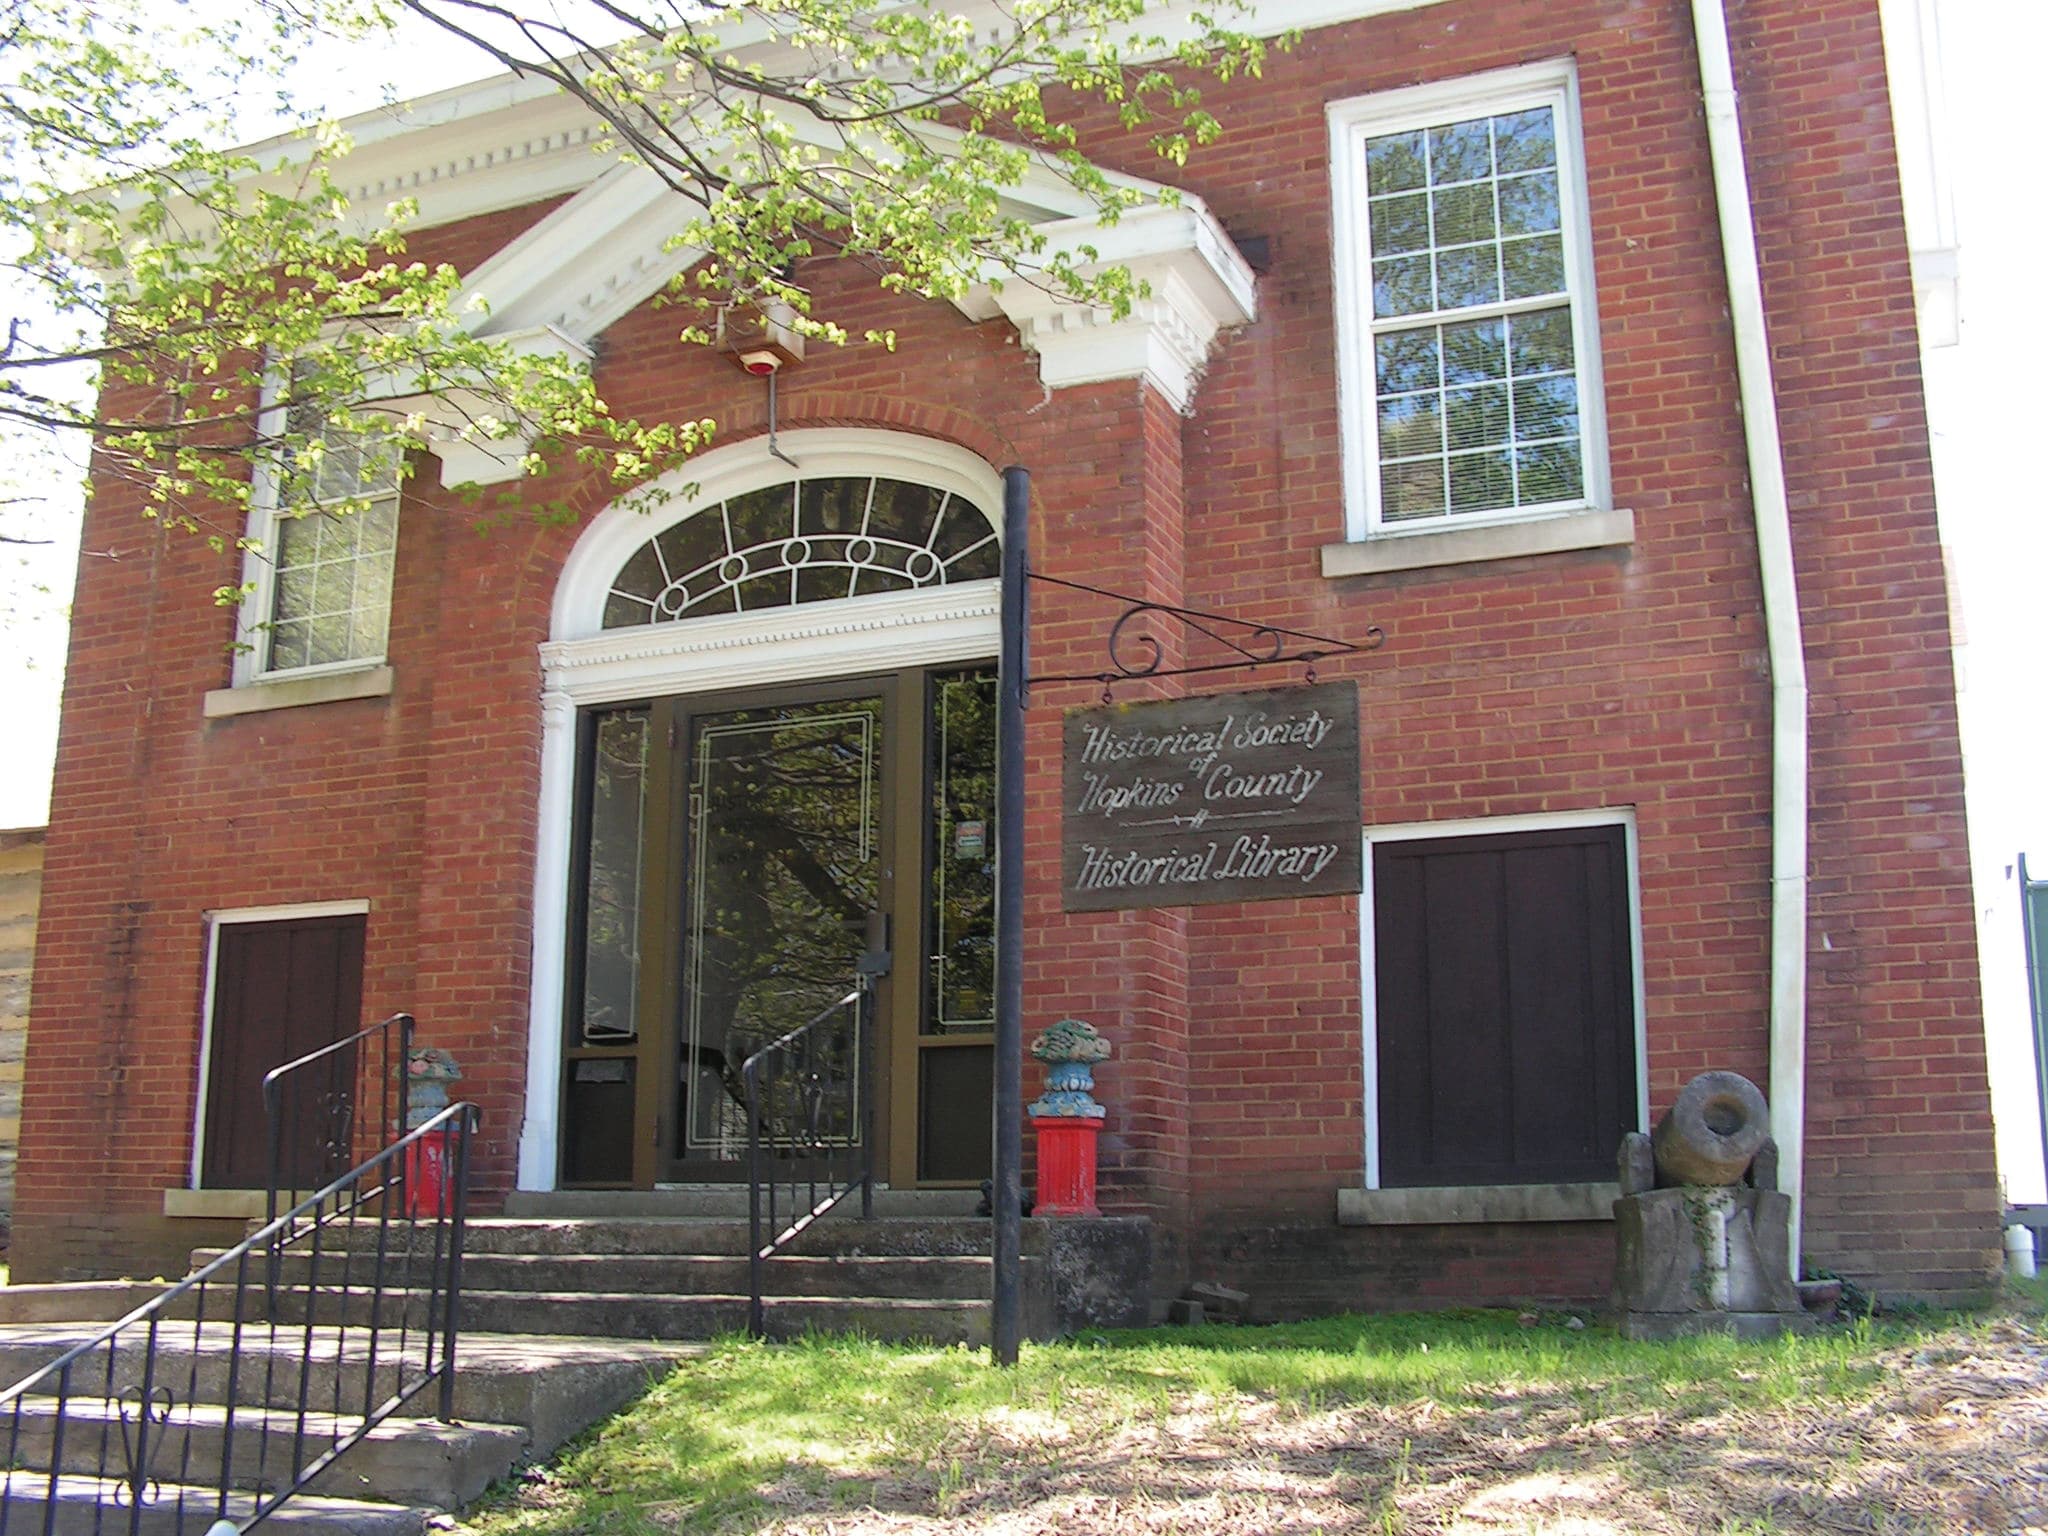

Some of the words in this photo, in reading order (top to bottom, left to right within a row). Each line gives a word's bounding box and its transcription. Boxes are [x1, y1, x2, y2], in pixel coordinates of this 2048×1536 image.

[1079, 714, 1234, 763] Historical
[1234, 711, 1334, 750] Society
[1078, 770, 1184, 818] Hopkins
[1204, 764, 1323, 804] County
[1188, 751, 1218, 779] of
[1075, 843, 1218, 891] Historical
[1213, 834, 1339, 884] Library
